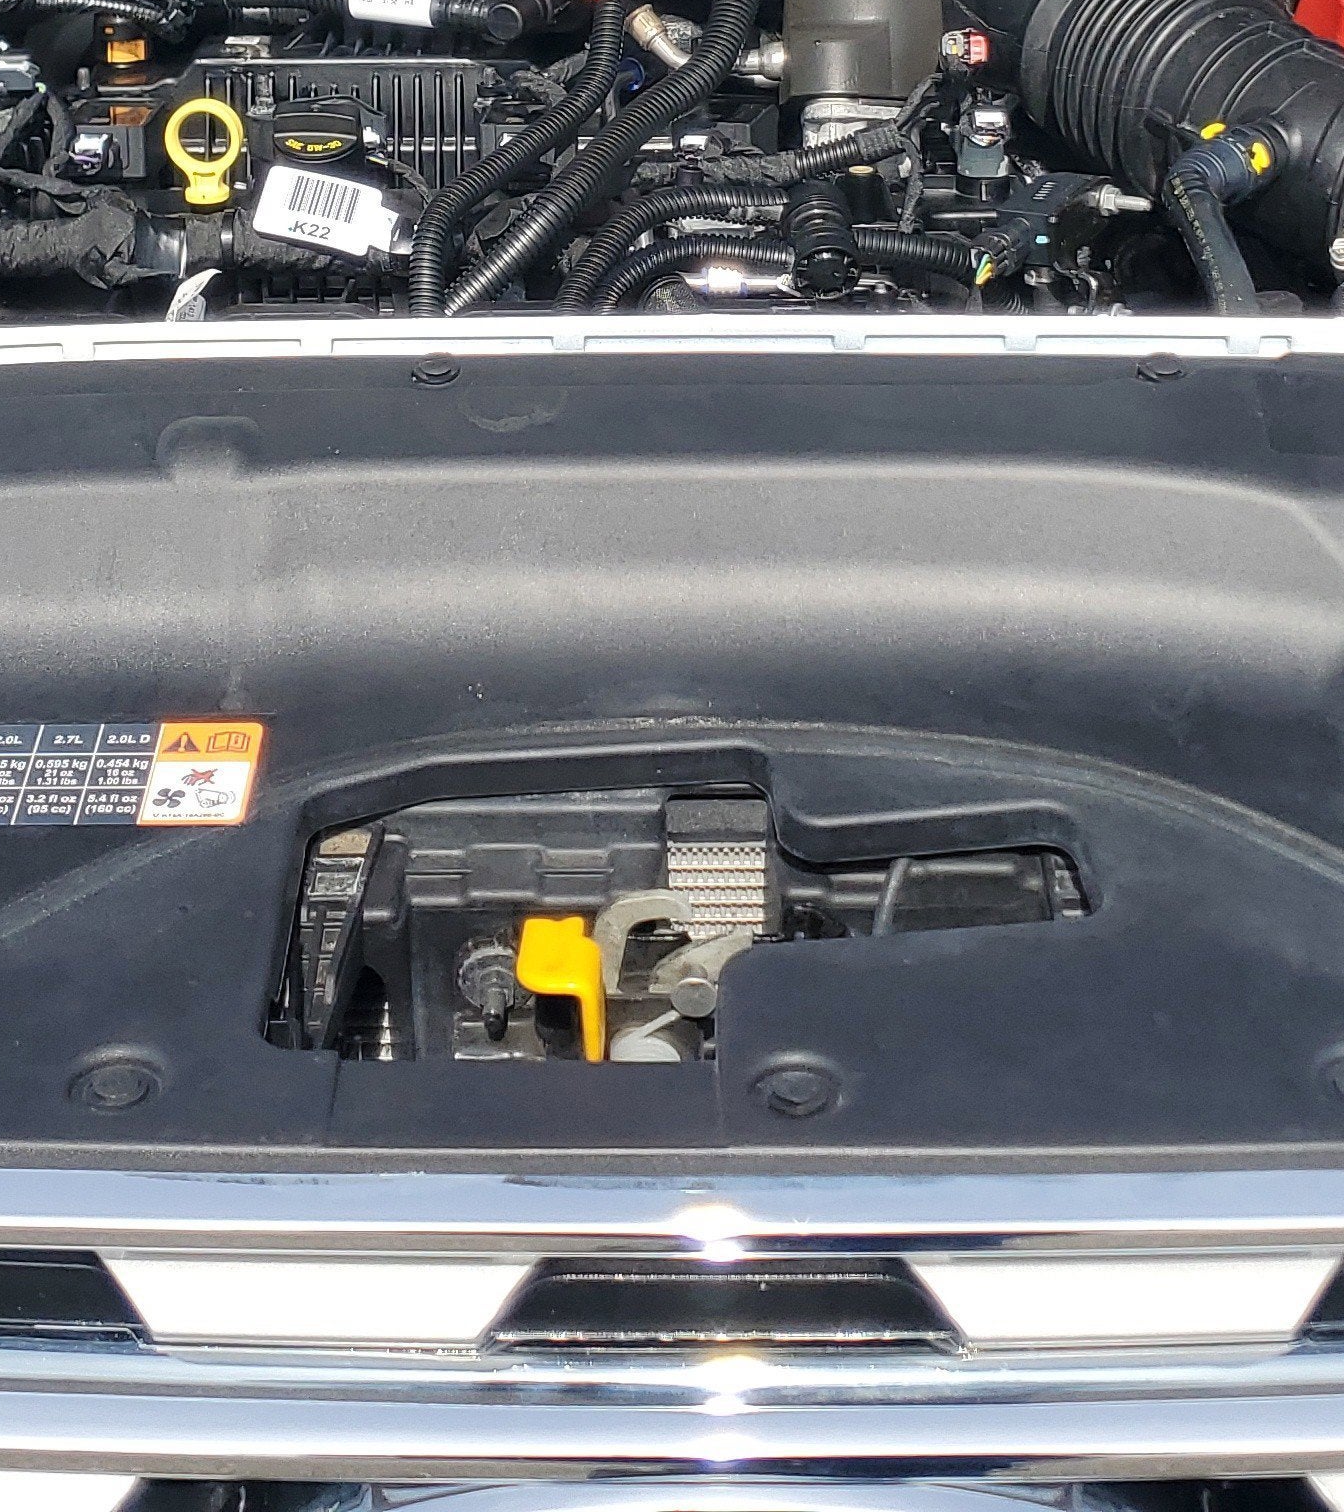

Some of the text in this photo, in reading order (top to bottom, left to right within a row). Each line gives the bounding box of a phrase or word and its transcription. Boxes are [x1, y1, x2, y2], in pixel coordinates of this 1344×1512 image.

[292, 220, 331, 240] K22
[53, 734, 84, 744] 2.7L
[106, 734, 151, 744] 2.0L D
[10, 759, 27, 771] kg
[35, 758, 88, 770] 0.595 kg
[96, 758, 150, 770] 0.454 kg
[44, 769, 58, 777] 21
[36, 777, 77, 786] 1.31 lbs
[97, 777, 139, 785] 1.00 lbs
[25, 794, 78, 804] 3.2 fl oz
[109, 793, 120, 803] fl
[121, 795, 138, 803] oz
[27, 804, 72, 815] (95 cc)
[84, 804, 137, 815] (160 cc)
